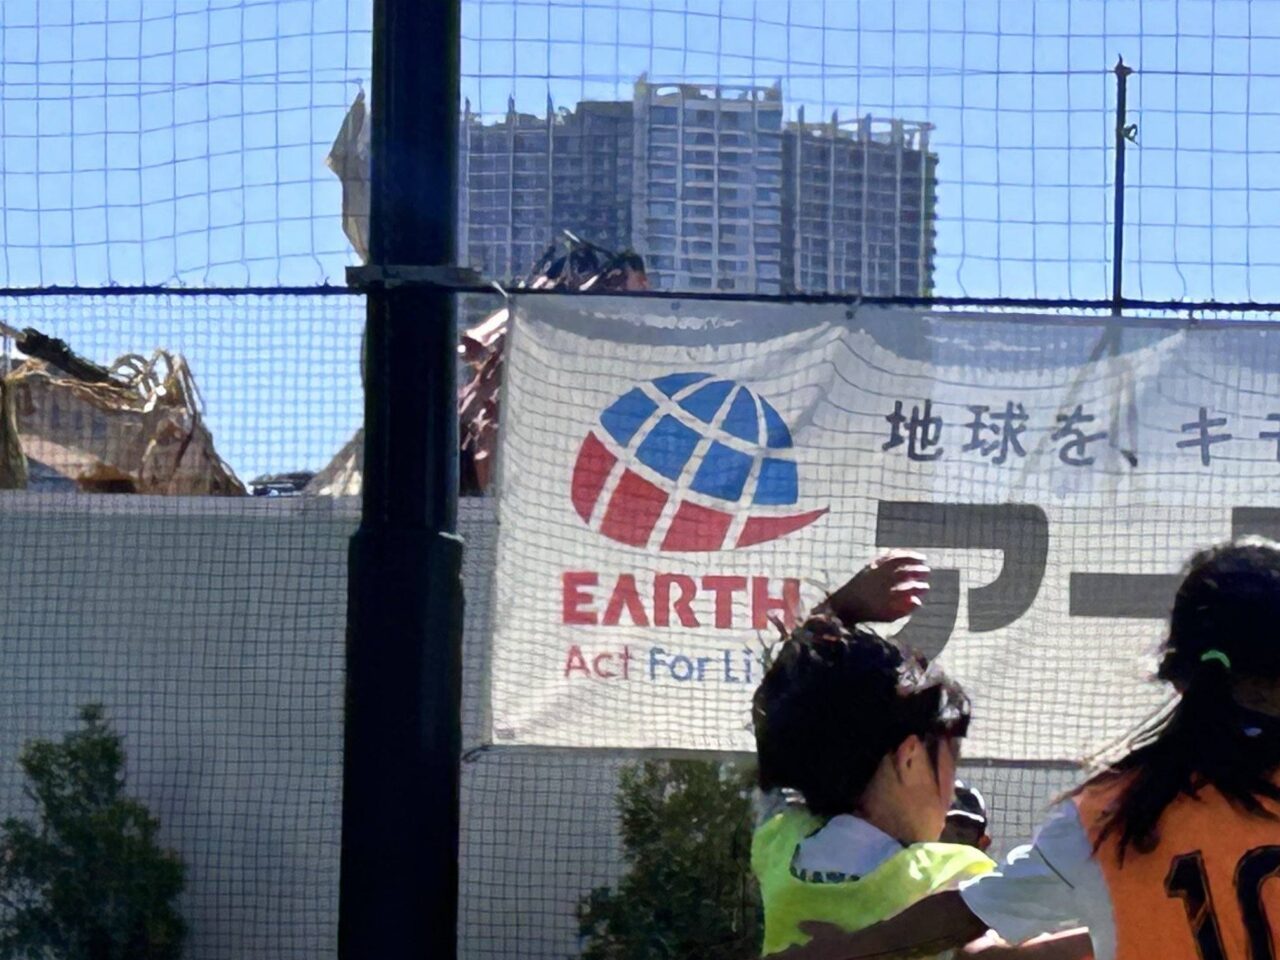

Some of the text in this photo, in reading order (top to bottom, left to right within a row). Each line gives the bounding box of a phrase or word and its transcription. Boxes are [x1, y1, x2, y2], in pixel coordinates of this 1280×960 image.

[562, 571, 799, 629] EARTH
[564, 645, 632, 679] Act
[650, 646, 708, 681] For
